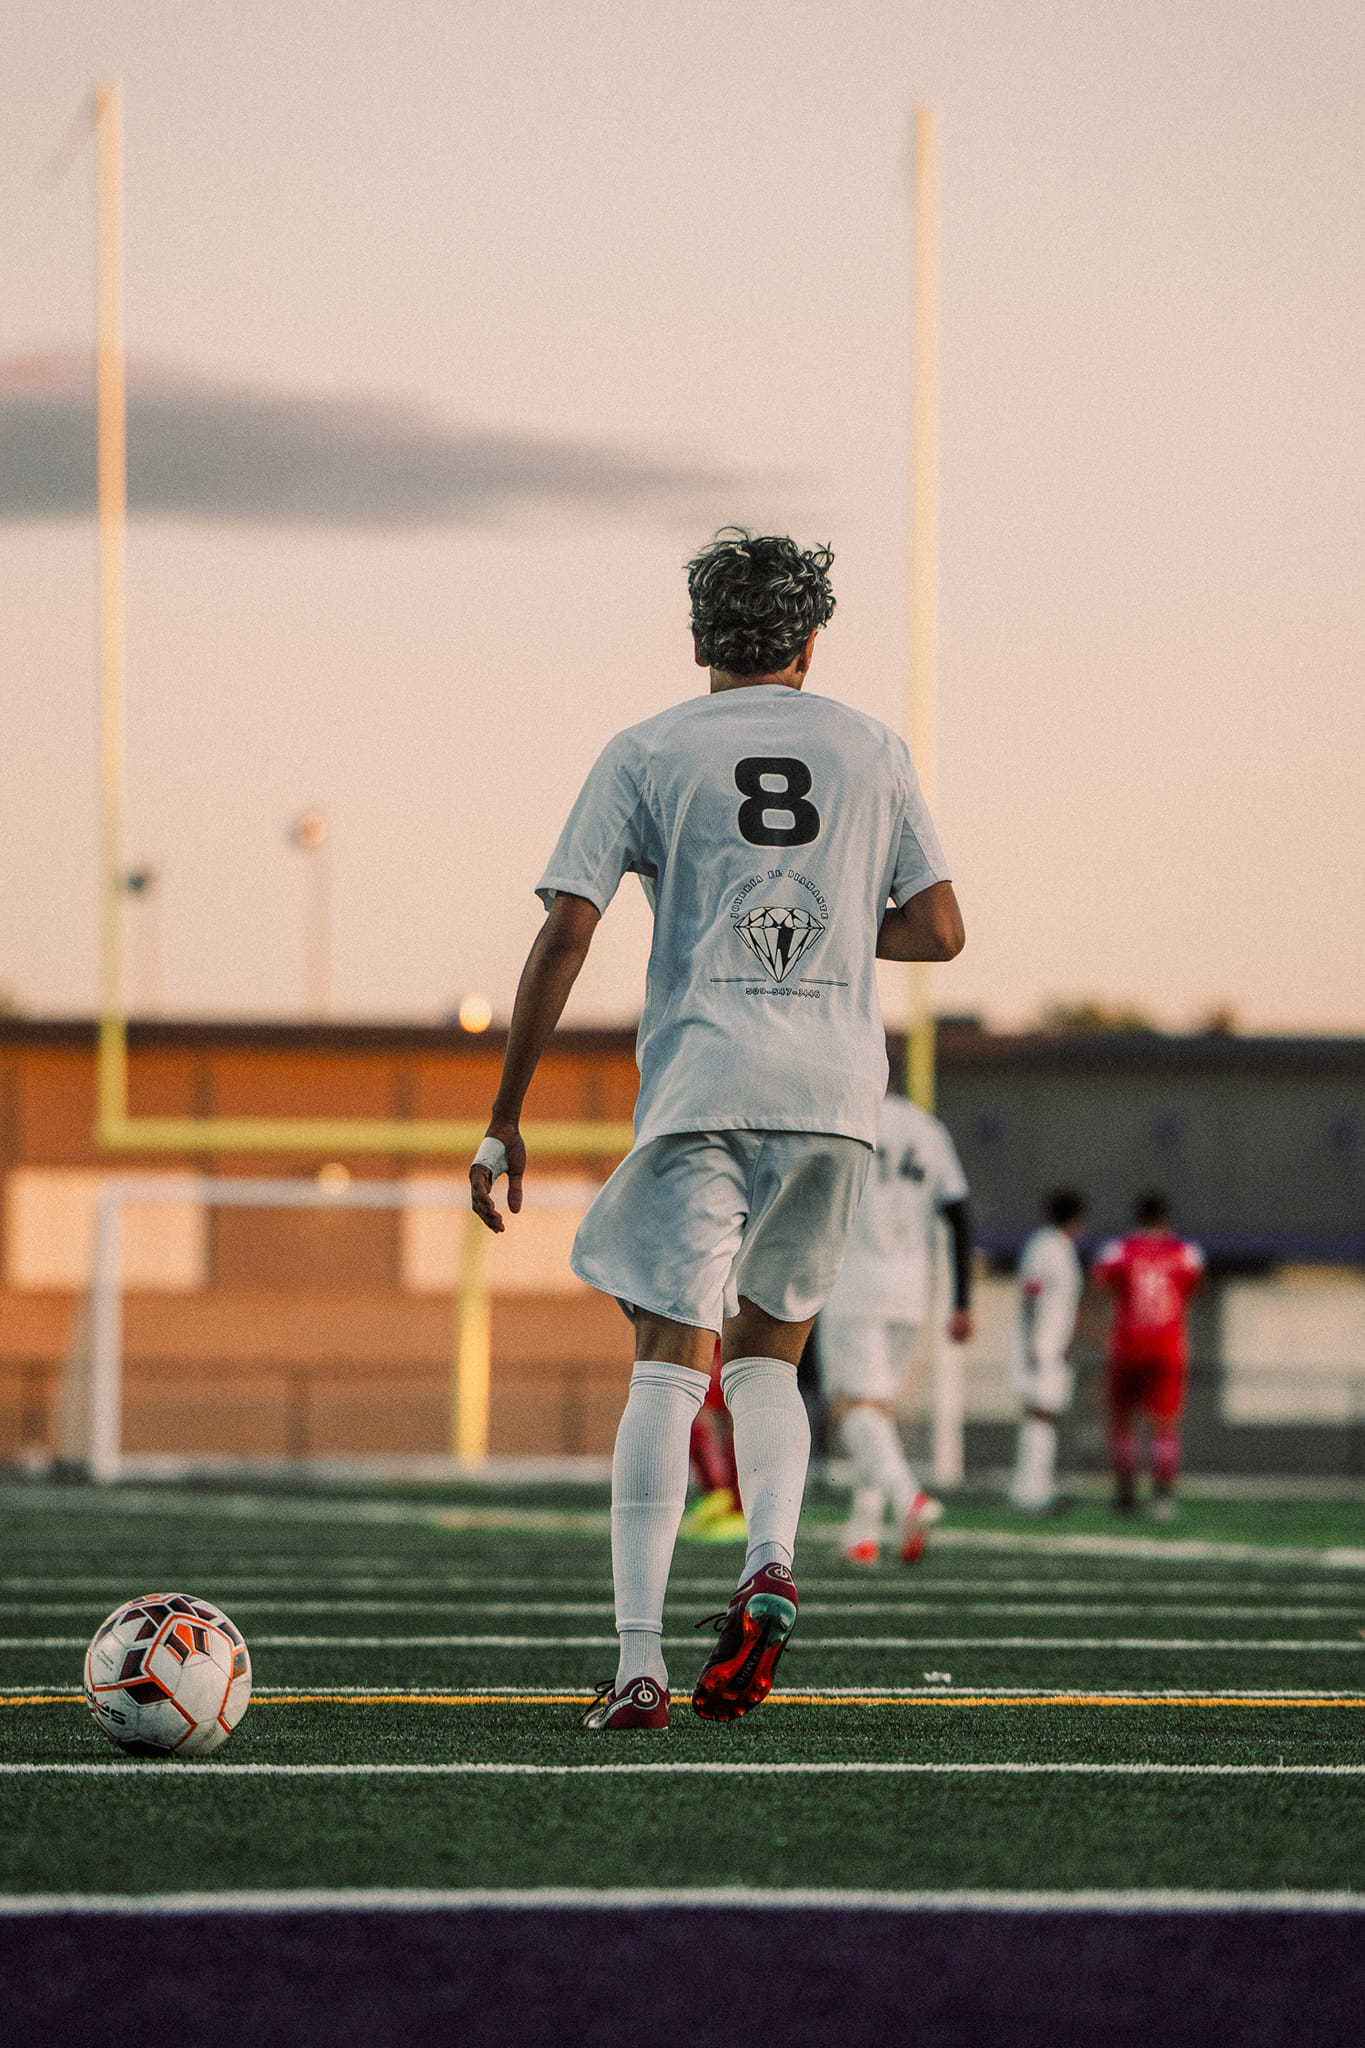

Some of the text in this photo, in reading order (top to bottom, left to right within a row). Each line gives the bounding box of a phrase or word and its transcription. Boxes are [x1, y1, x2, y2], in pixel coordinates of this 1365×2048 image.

[734, 756, 821, 847] 8
[730, 869, 829, 920] JOYERIA EL DIAMANTE
